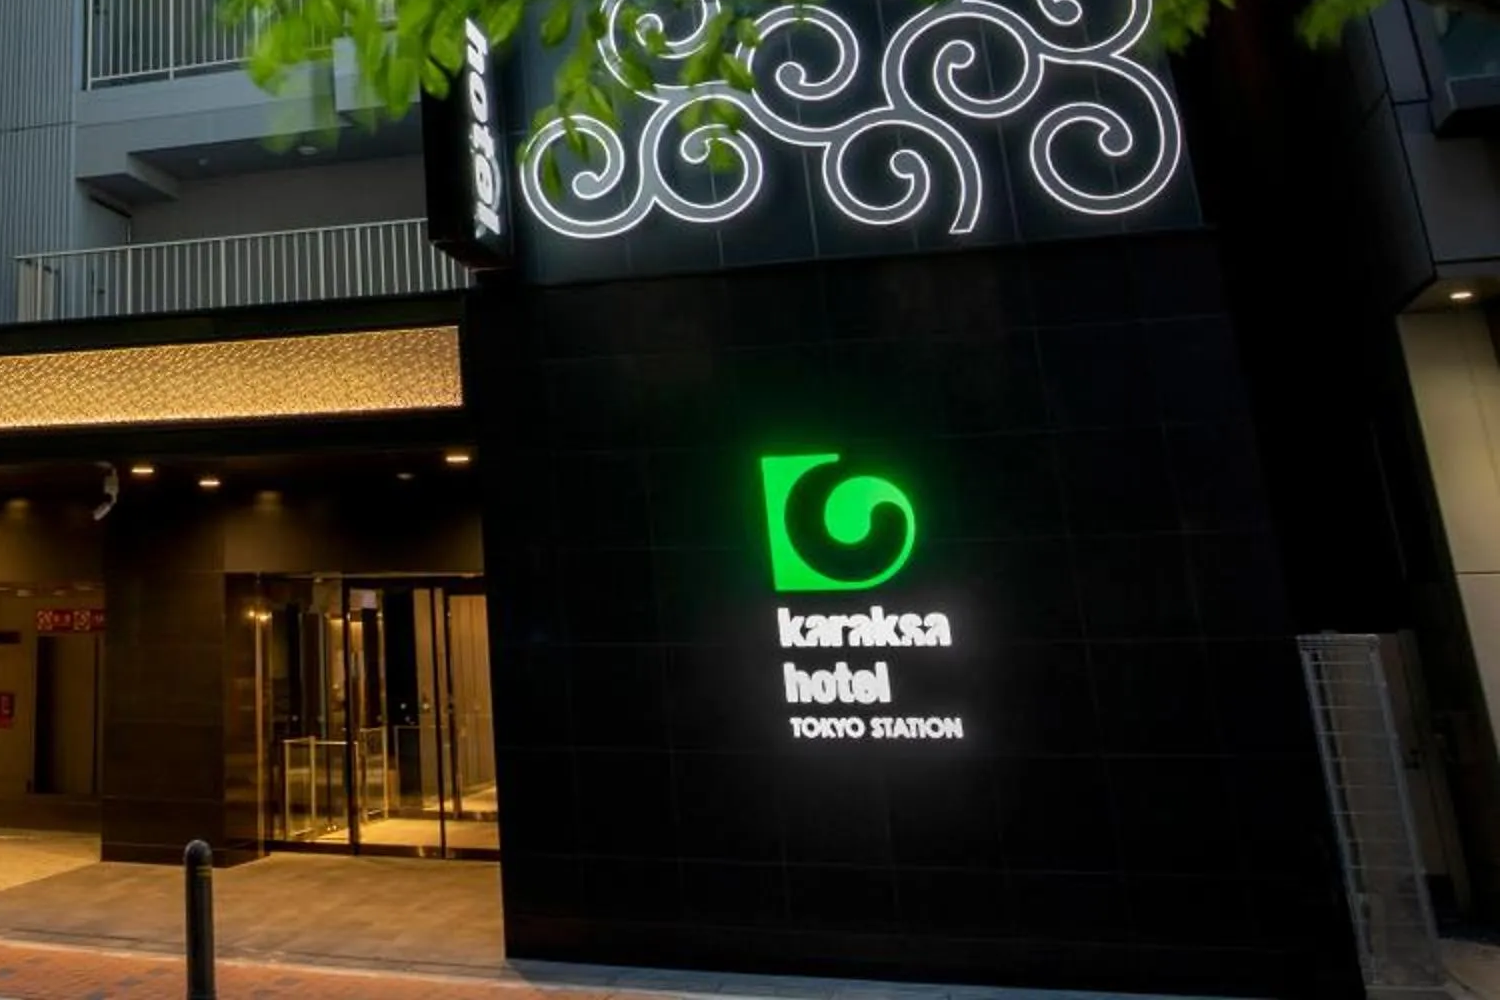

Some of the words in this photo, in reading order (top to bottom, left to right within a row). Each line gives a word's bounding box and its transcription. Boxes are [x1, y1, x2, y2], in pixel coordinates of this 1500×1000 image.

[465, 17, 500, 236] hotel
[776, 605, 952, 648] karaksa
[783, 661, 891, 703] hotel
[789, 716, 866, 739] TOKYO
[870, 716, 964, 740] STATION
